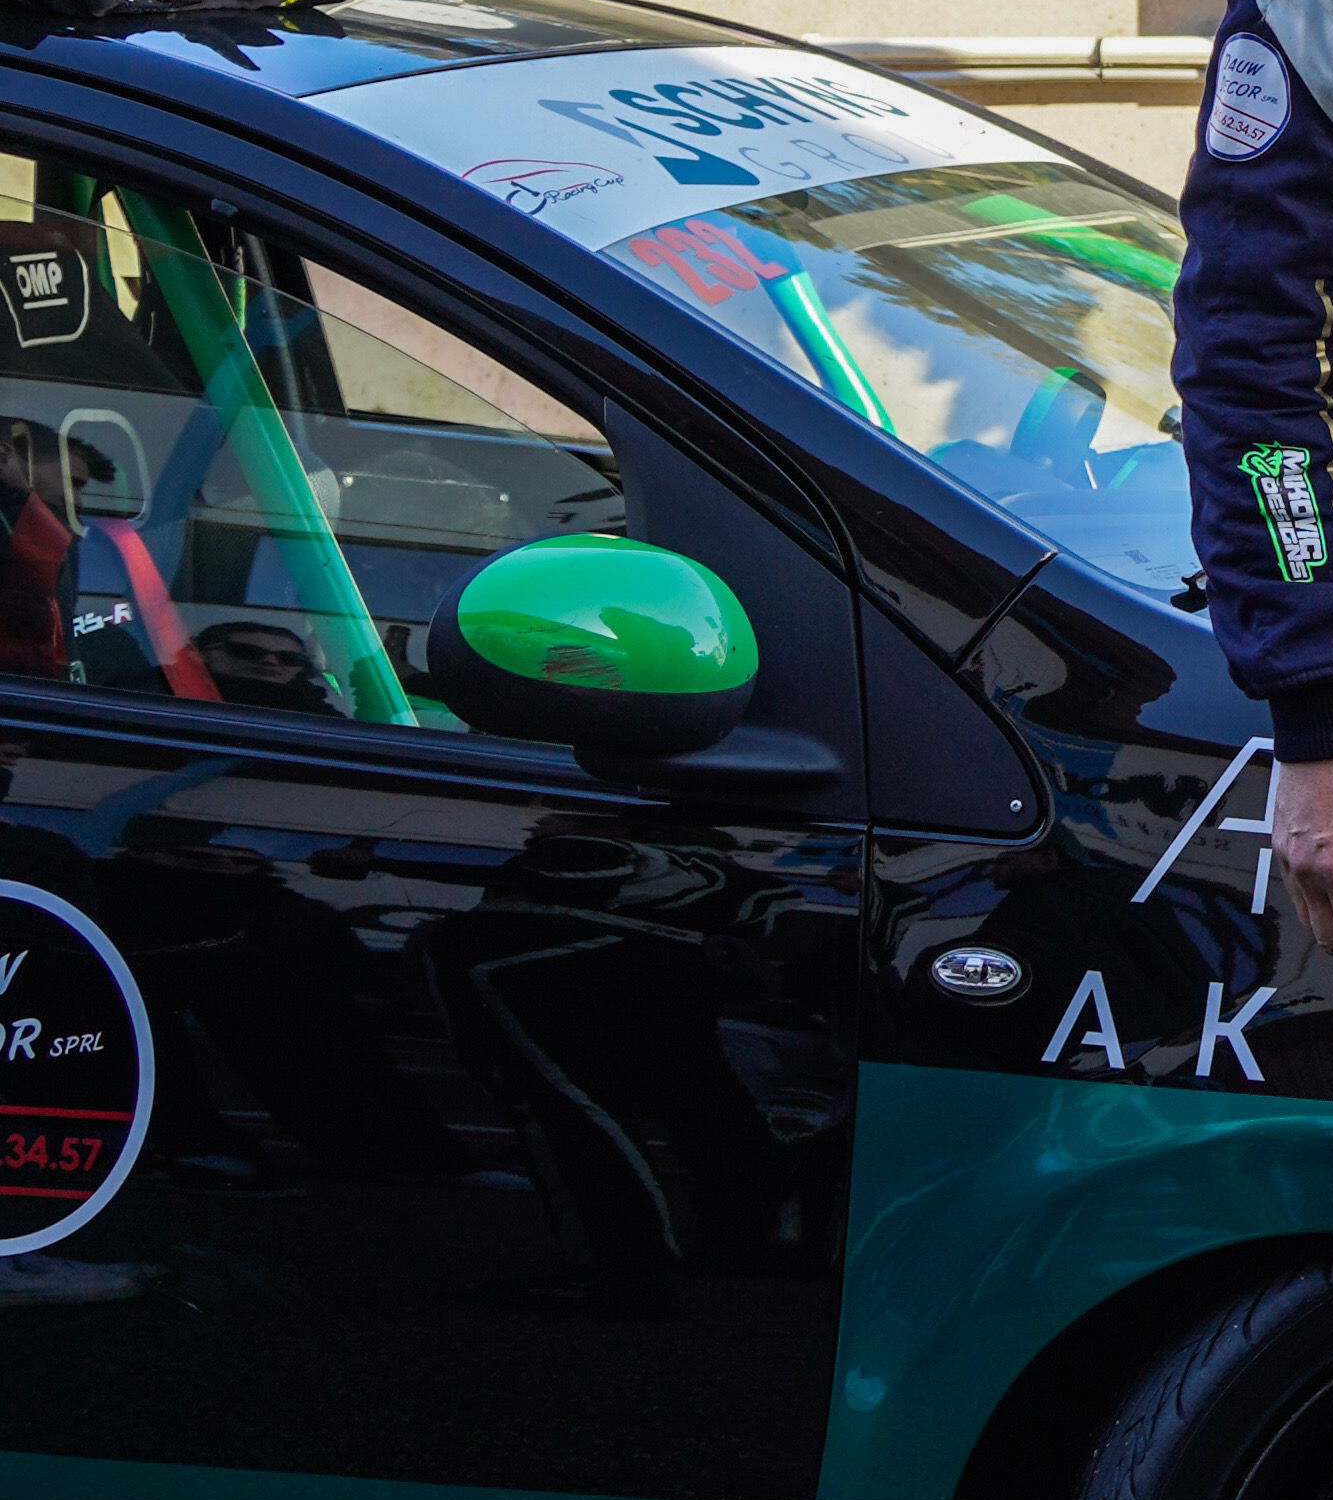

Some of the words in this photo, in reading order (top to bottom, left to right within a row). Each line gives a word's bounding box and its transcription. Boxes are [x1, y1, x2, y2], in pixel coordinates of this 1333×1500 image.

[607, 77, 910, 137] SCHYNS
[543, 182, 598, 204] Racing
[593, 174, 624, 187] Cup
[16, 261, 63, 298] OMP
[628, 219, 788, 306] 232
[1281, 449, 1324, 561] MIKOVIC
[49, 1031, 105, 1058] SPRL
